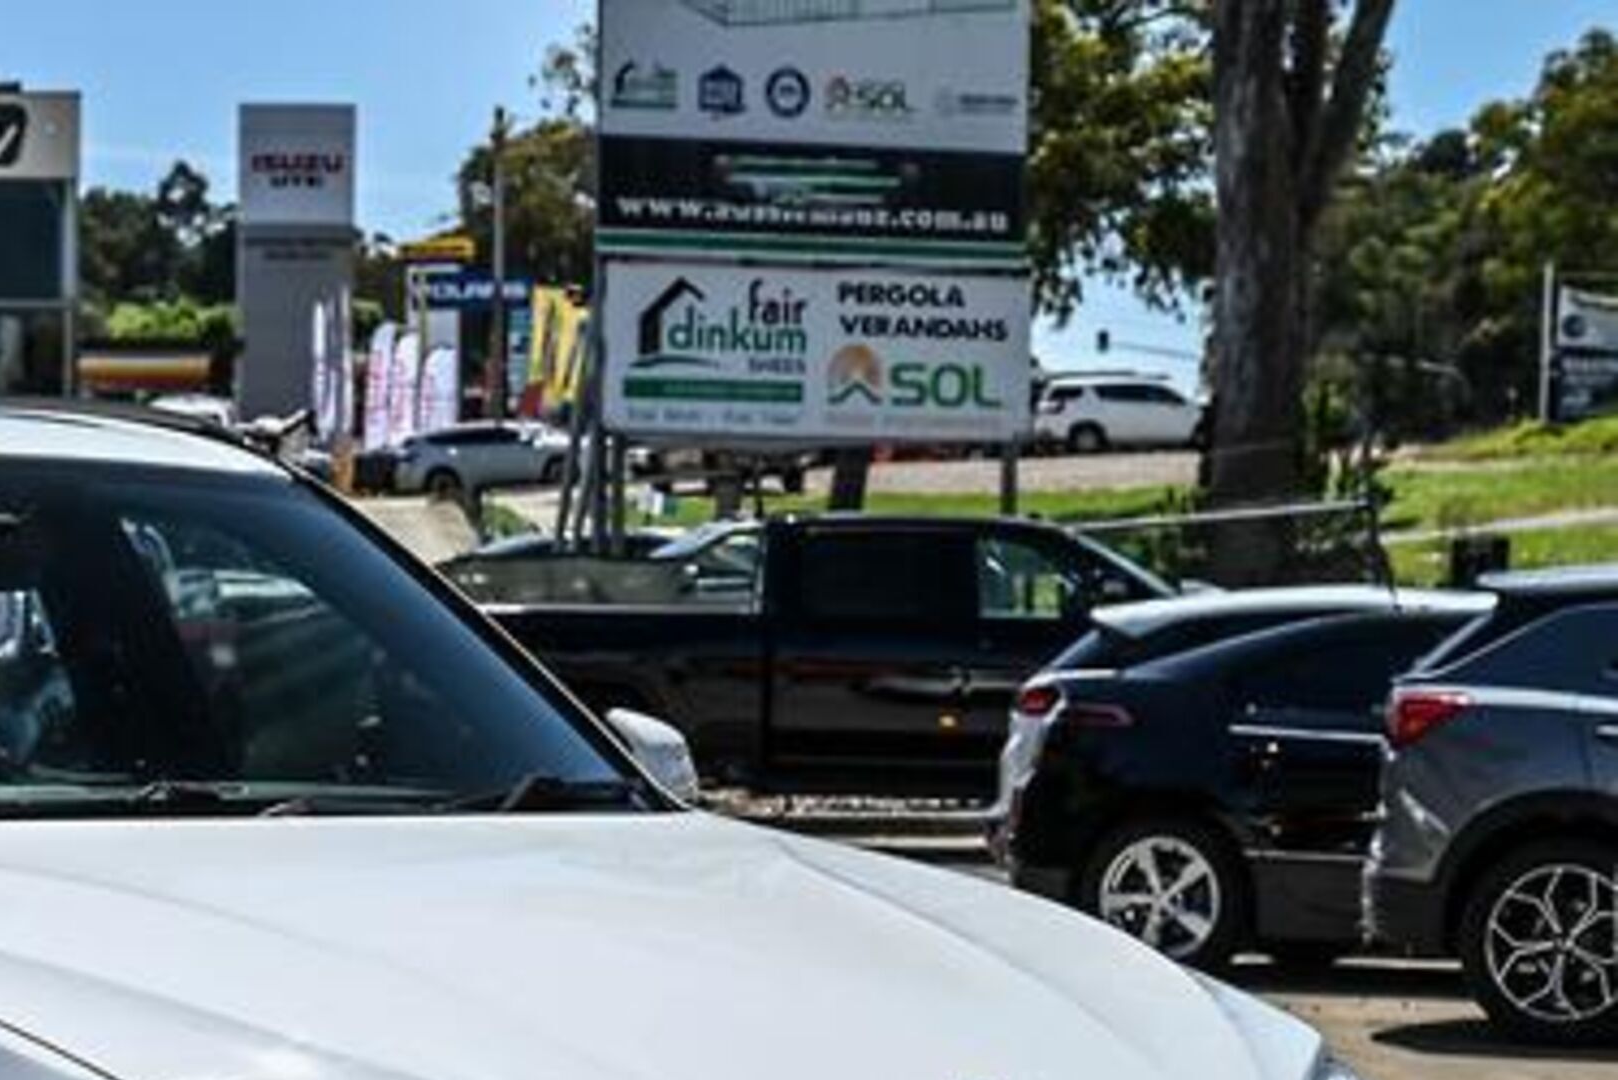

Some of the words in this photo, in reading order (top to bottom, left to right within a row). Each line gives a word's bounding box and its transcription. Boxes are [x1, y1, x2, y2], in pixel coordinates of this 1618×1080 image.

[748, 278, 808, 327] fair
[838, 283, 964, 308] PERGOLA
[668, 306, 807, 353] dinkum
[840, 316, 1008, 341] VERANDAHS
[889, 363, 1002, 408] SOL
